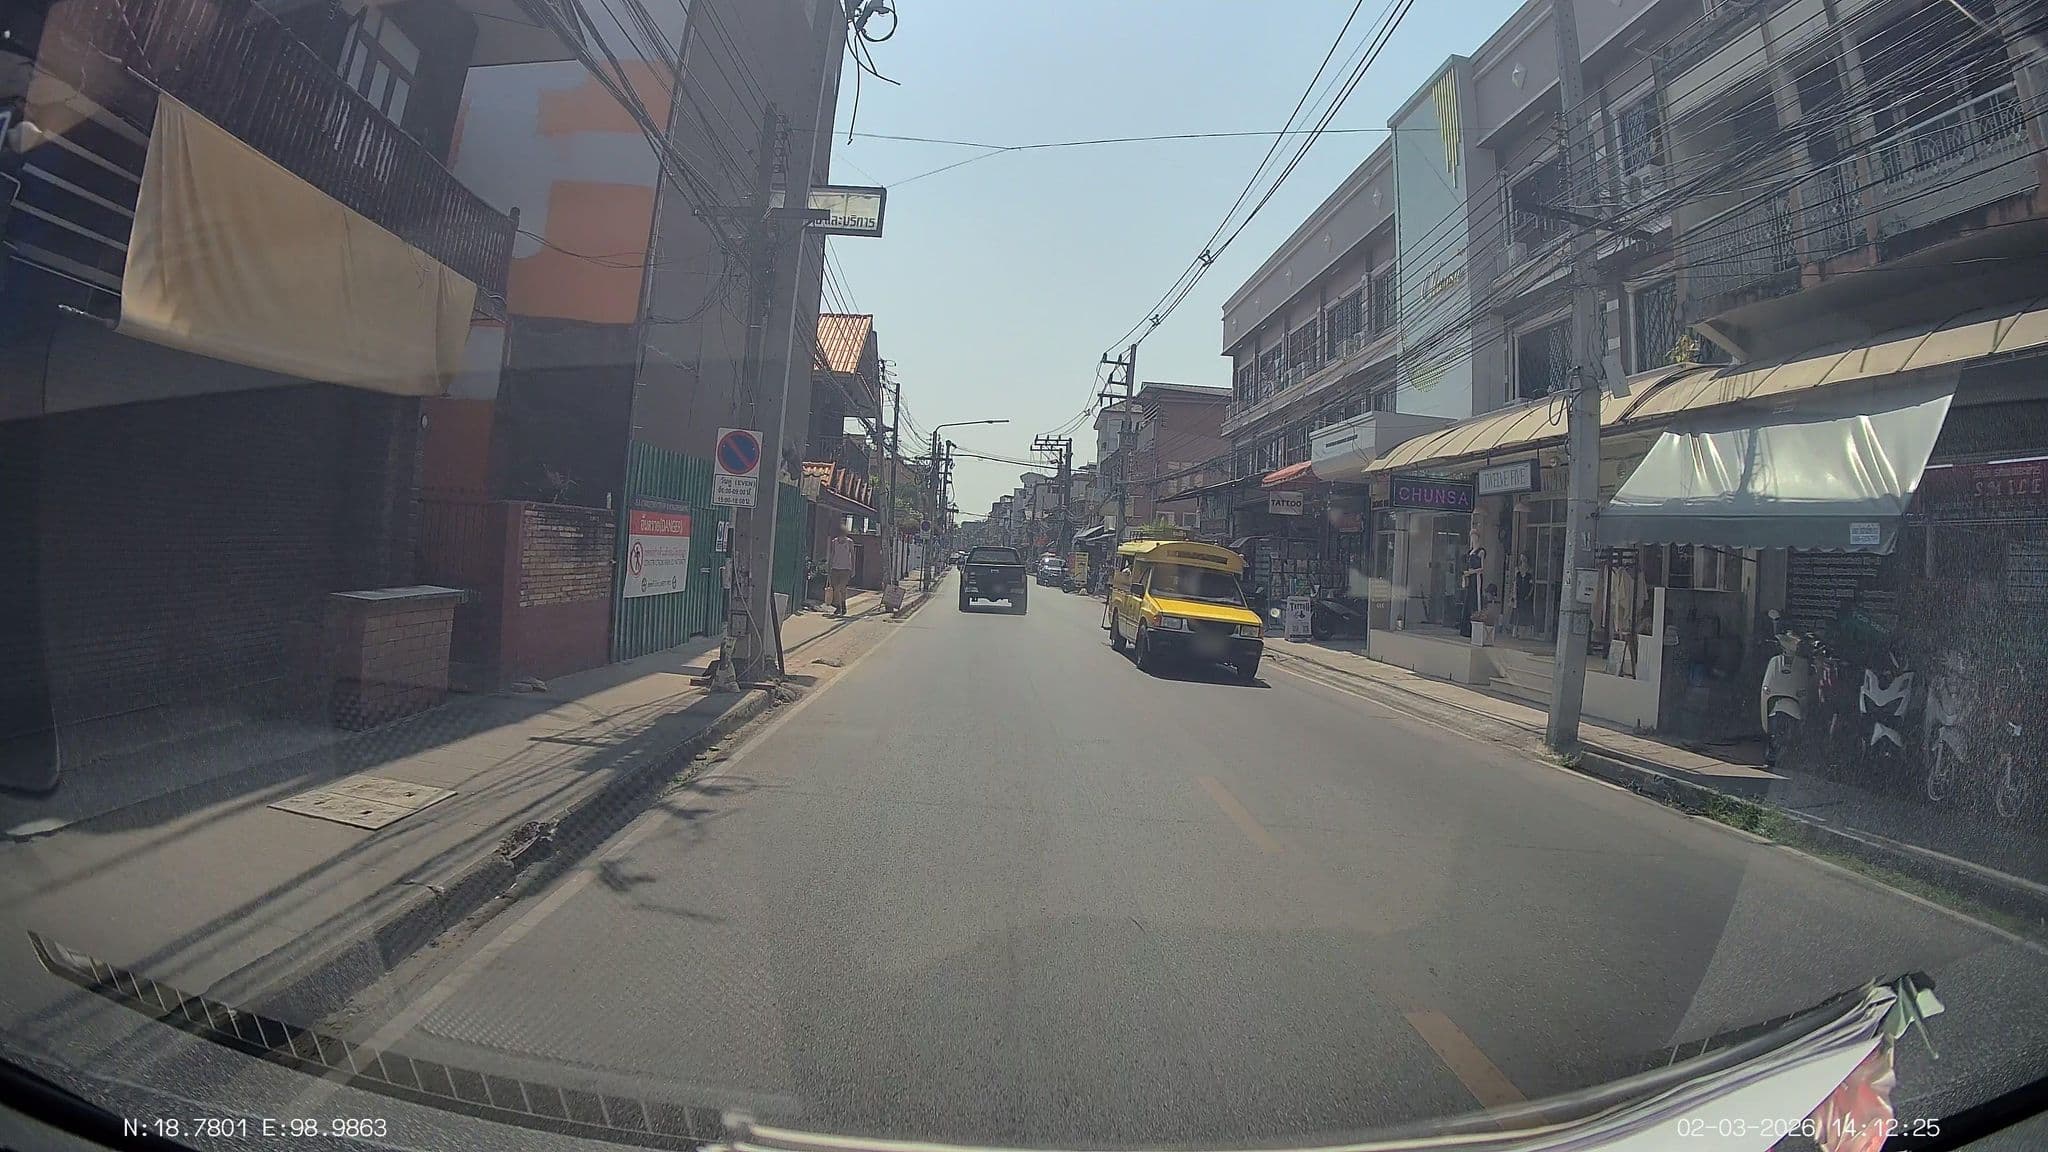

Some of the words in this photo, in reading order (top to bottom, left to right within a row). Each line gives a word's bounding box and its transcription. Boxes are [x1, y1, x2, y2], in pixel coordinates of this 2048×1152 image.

[1483, 471, 1509, 489] TWELVE
[1510, 468, 1526, 487] FIVE
[1271, 499, 1302, 507] TATTOO
[1399, 486, 1468, 506] CHUNSA
